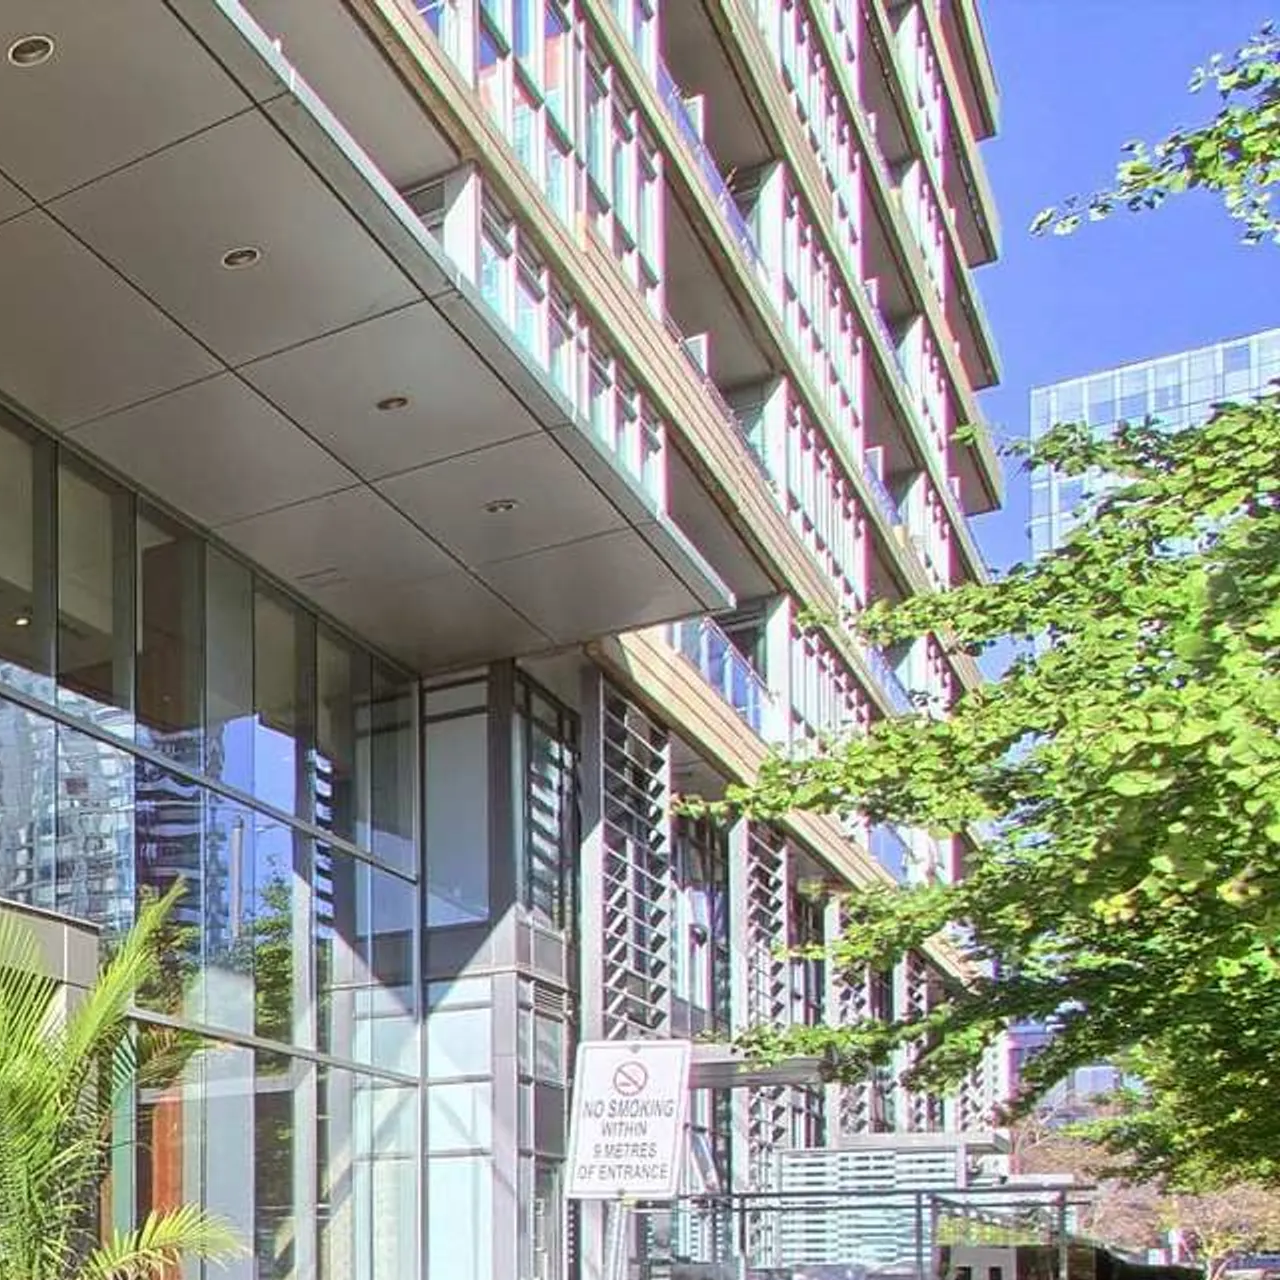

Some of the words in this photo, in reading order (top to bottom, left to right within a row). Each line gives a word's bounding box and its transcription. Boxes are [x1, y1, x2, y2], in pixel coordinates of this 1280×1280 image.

[583, 1100, 605, 1118] NO
[607, 1099, 675, 1118] SMOKING
[601, 1120, 648, 1137] WITHIN
[603, 1142, 658, 1159] METRES
[577, 1164, 596, 1180] OF
[598, 1163, 669, 1181] ENTRANCE
